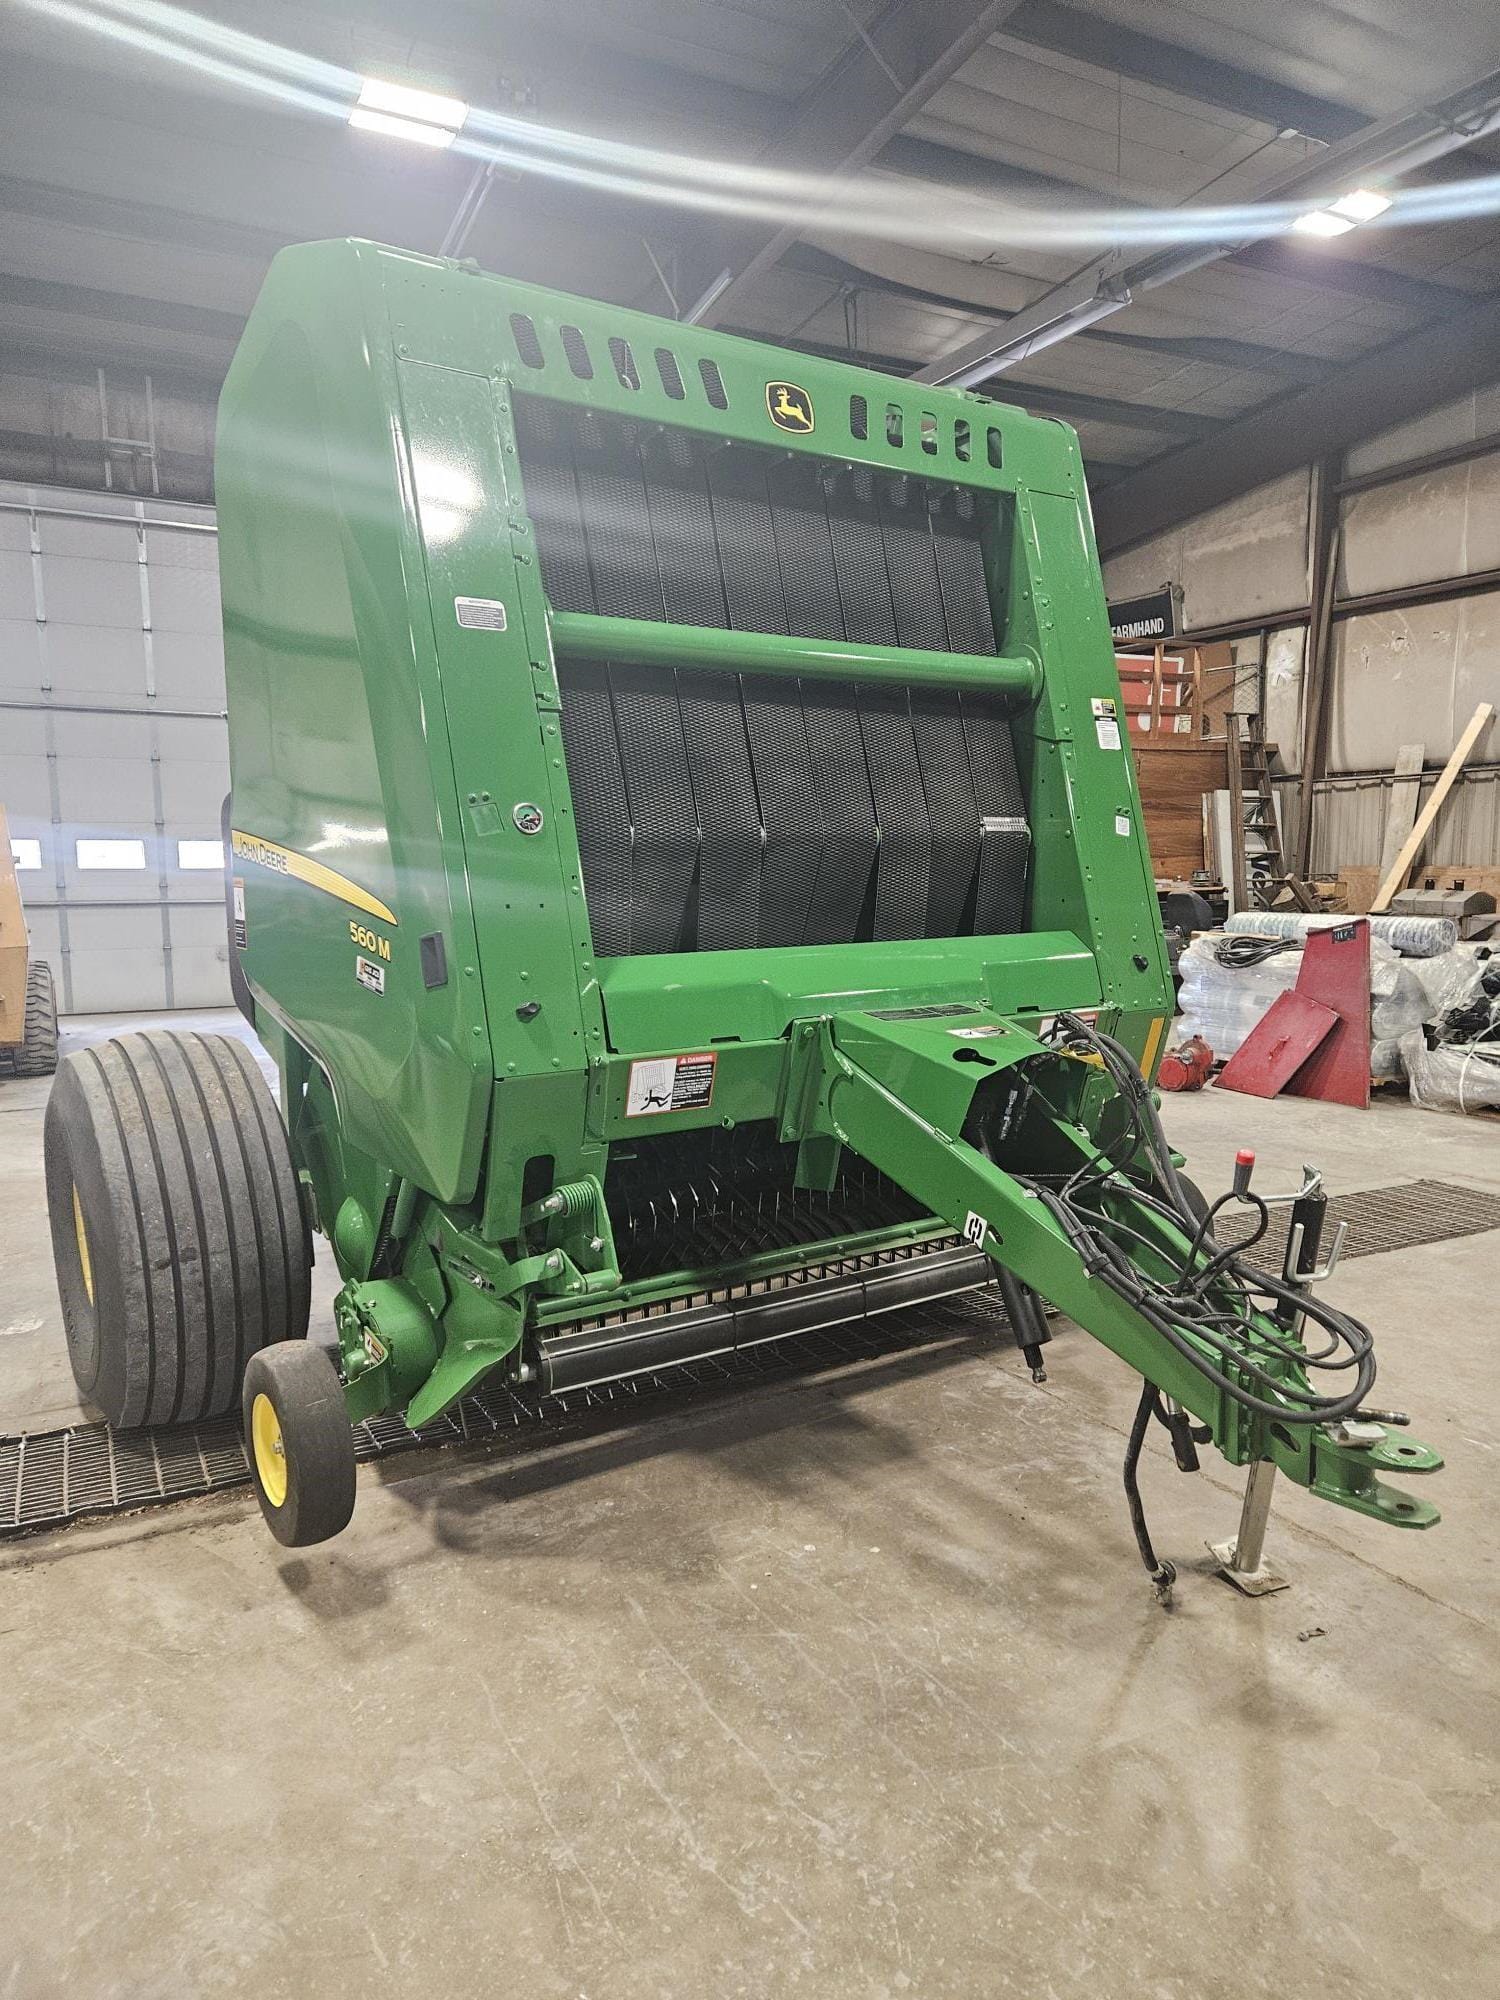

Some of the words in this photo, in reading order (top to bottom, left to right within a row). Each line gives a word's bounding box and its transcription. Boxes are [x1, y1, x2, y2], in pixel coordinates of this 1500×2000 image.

[1111, 617, 1165, 639] FARMHAND
[259, 843, 288, 873] DEERE
[349, 919, 377, 954] 560
[377, 934, 391, 963] M
